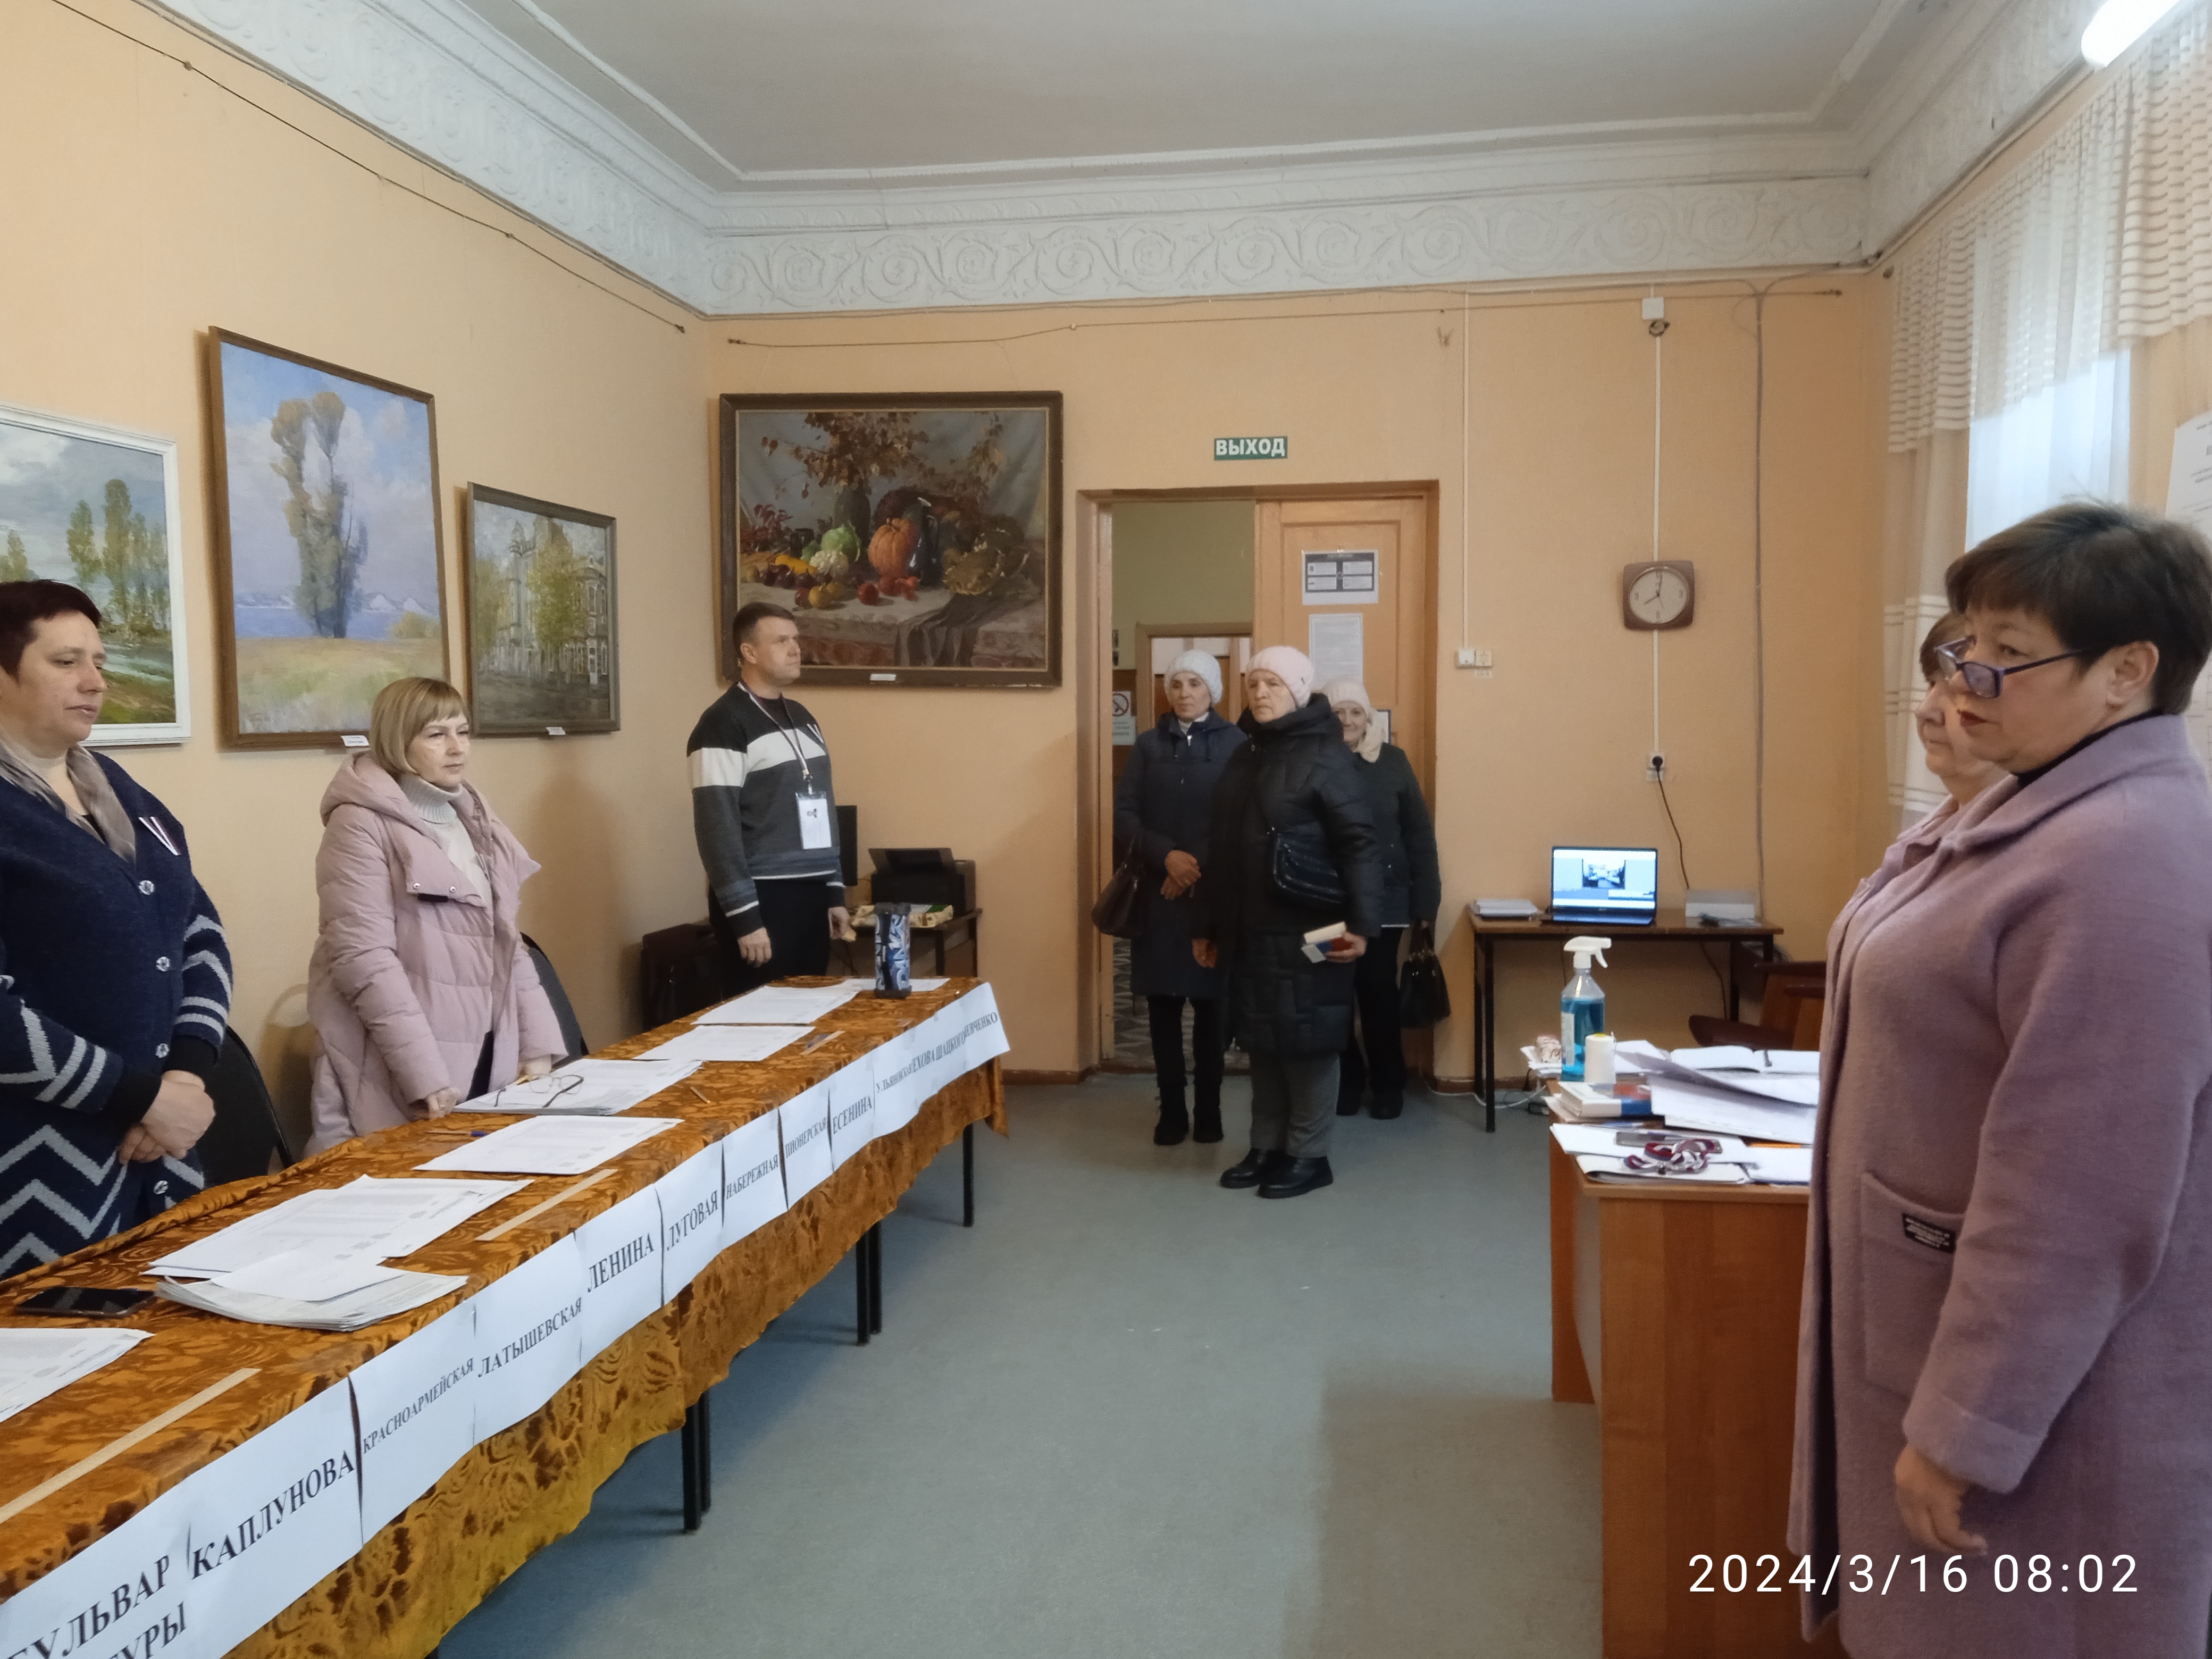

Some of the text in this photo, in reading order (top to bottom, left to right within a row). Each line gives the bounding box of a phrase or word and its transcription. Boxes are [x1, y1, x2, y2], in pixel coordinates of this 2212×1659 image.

[1216, 438, 1285, 458] ВЫХОД
[785, 1117, 827, 1159] ПИОНЕРСКАЯ
[833, 1095, 873, 1135] ЕСЕНИНА
[726, 1154, 778, 1200] НАБЕРЕЖНАЯ
[666, 1189, 719, 1252] ЛУГОВАЯ
[587, 1232, 655, 1293] ЛЕНИНА
[477, 1296, 582, 1378] ЛАТЫШЕВСКАЯ
[363, 1357, 474, 1454] КРАСНОАРМЕЙСКАЯ
[191, 1449, 355, 1580] КАПЛУНОВА
